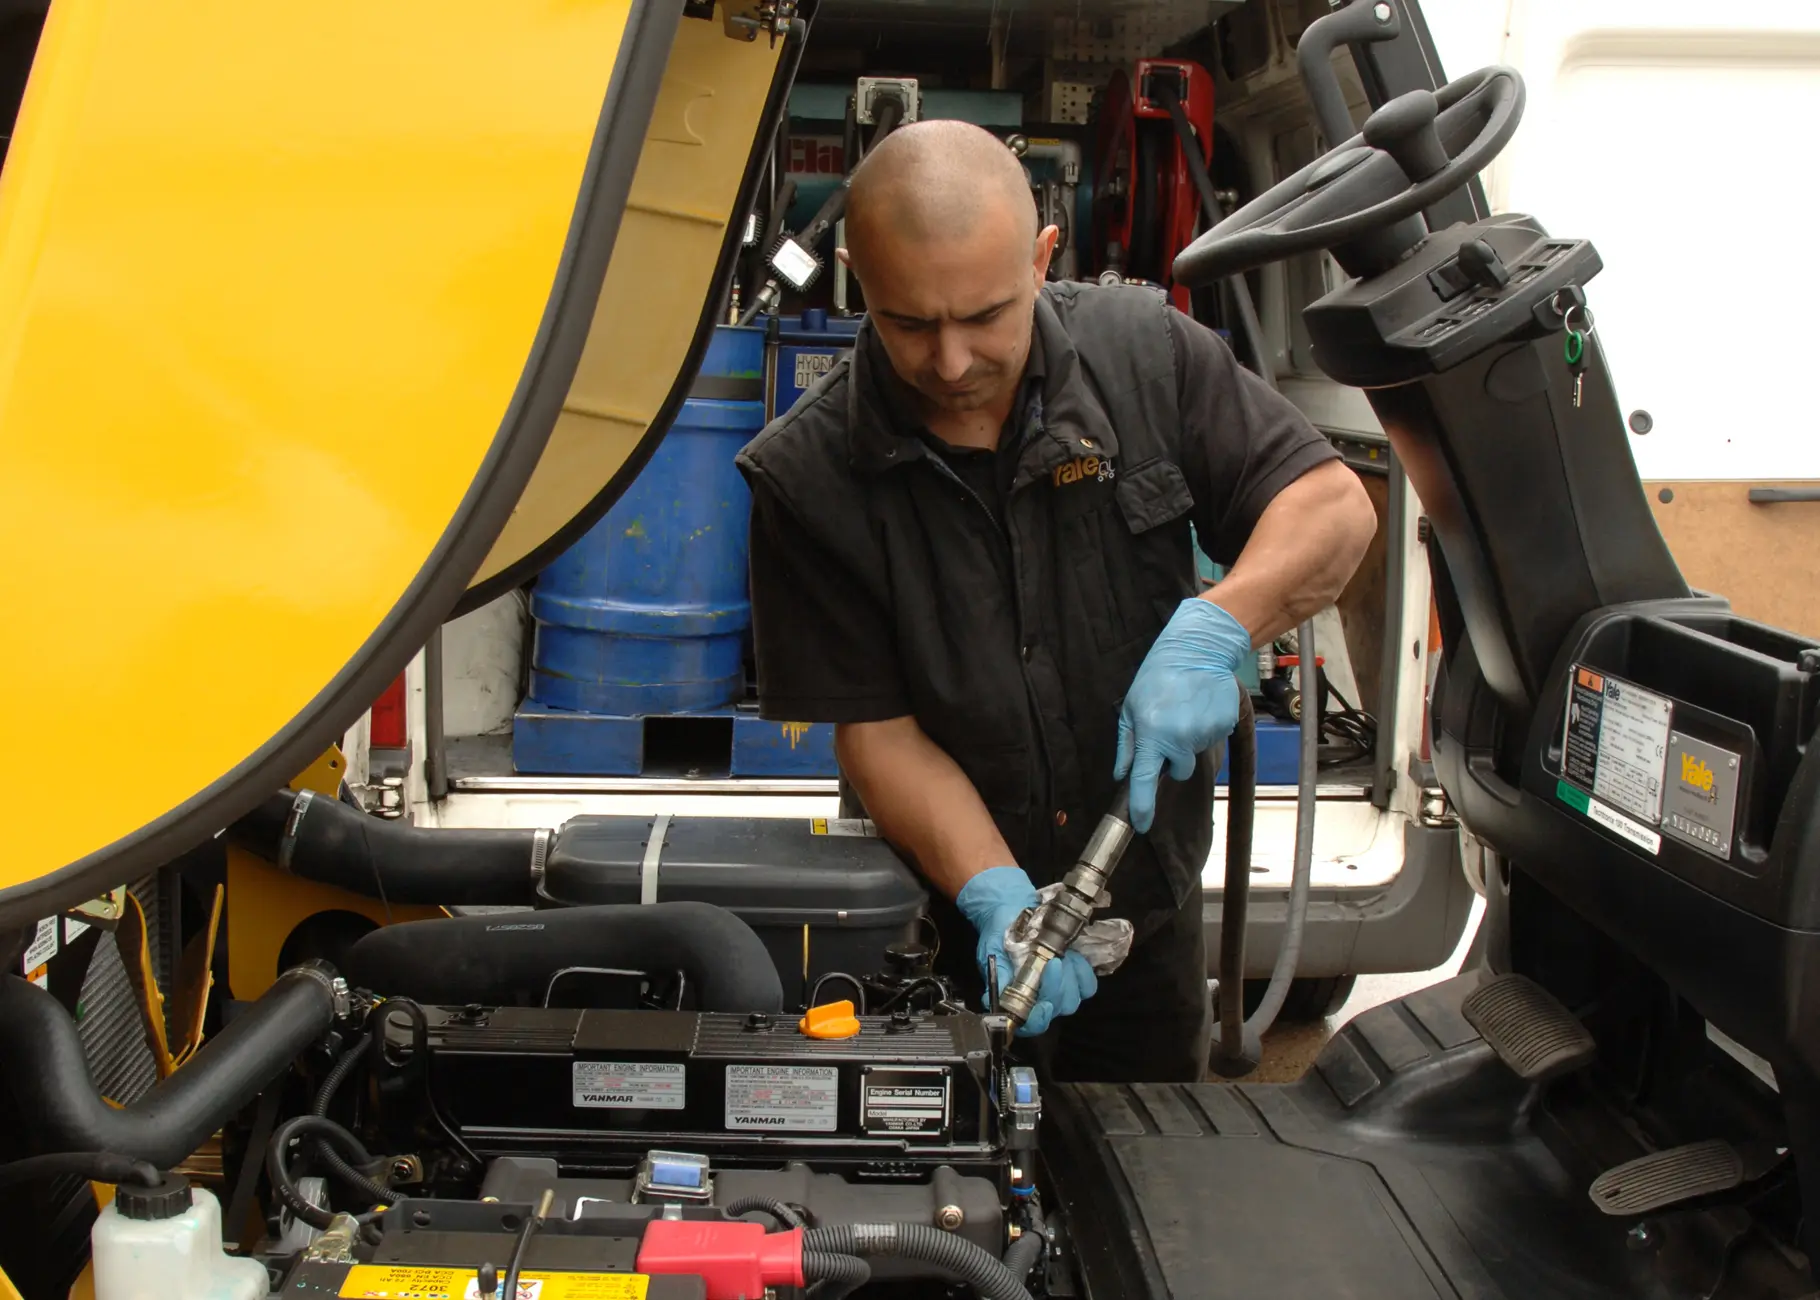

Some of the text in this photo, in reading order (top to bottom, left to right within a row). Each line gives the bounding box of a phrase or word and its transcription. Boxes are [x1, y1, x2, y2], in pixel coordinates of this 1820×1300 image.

[1605, 679, 1620, 701] Yale
[1681, 752, 1713, 791] Yale
[577, 1063, 680, 1073] IMPORTANT ENGINE INFORMATION
[730, 1067, 833, 1076] IMPORTANT ENGINE INFORMATION
[870, 1088, 892, 1096] Engine
[894, 1088, 913, 1096] Serial
[582, 1094, 633, 1103] YANMAR
[734, 1116, 786, 1125] YANMAR
